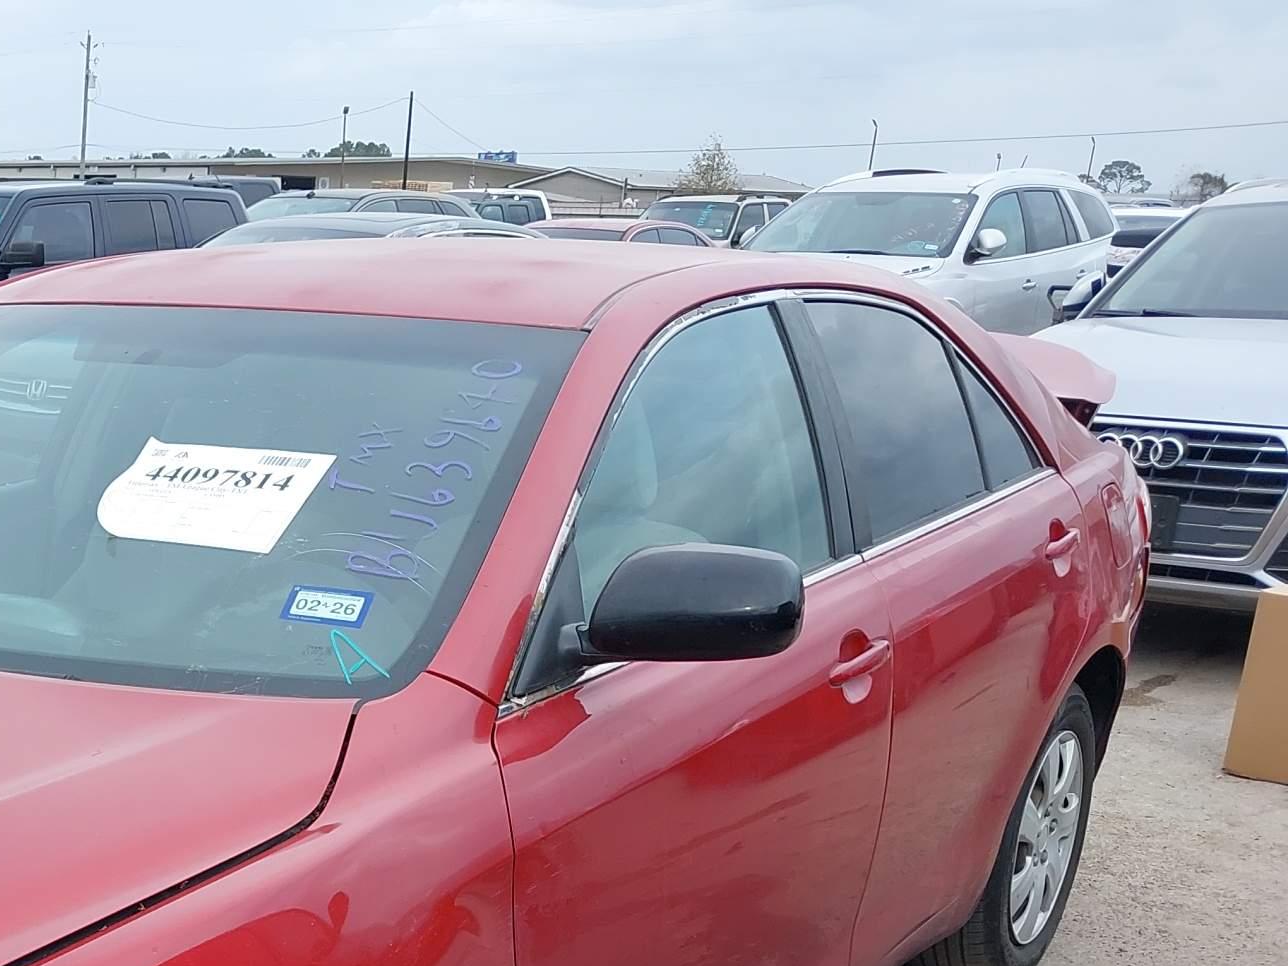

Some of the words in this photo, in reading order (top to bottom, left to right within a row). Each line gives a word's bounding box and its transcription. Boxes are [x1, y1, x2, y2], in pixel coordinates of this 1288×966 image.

[145, 464, 295, 492] 44097814
[295, 598, 322, 612] 02
[330, 602, 357, 616] 26
